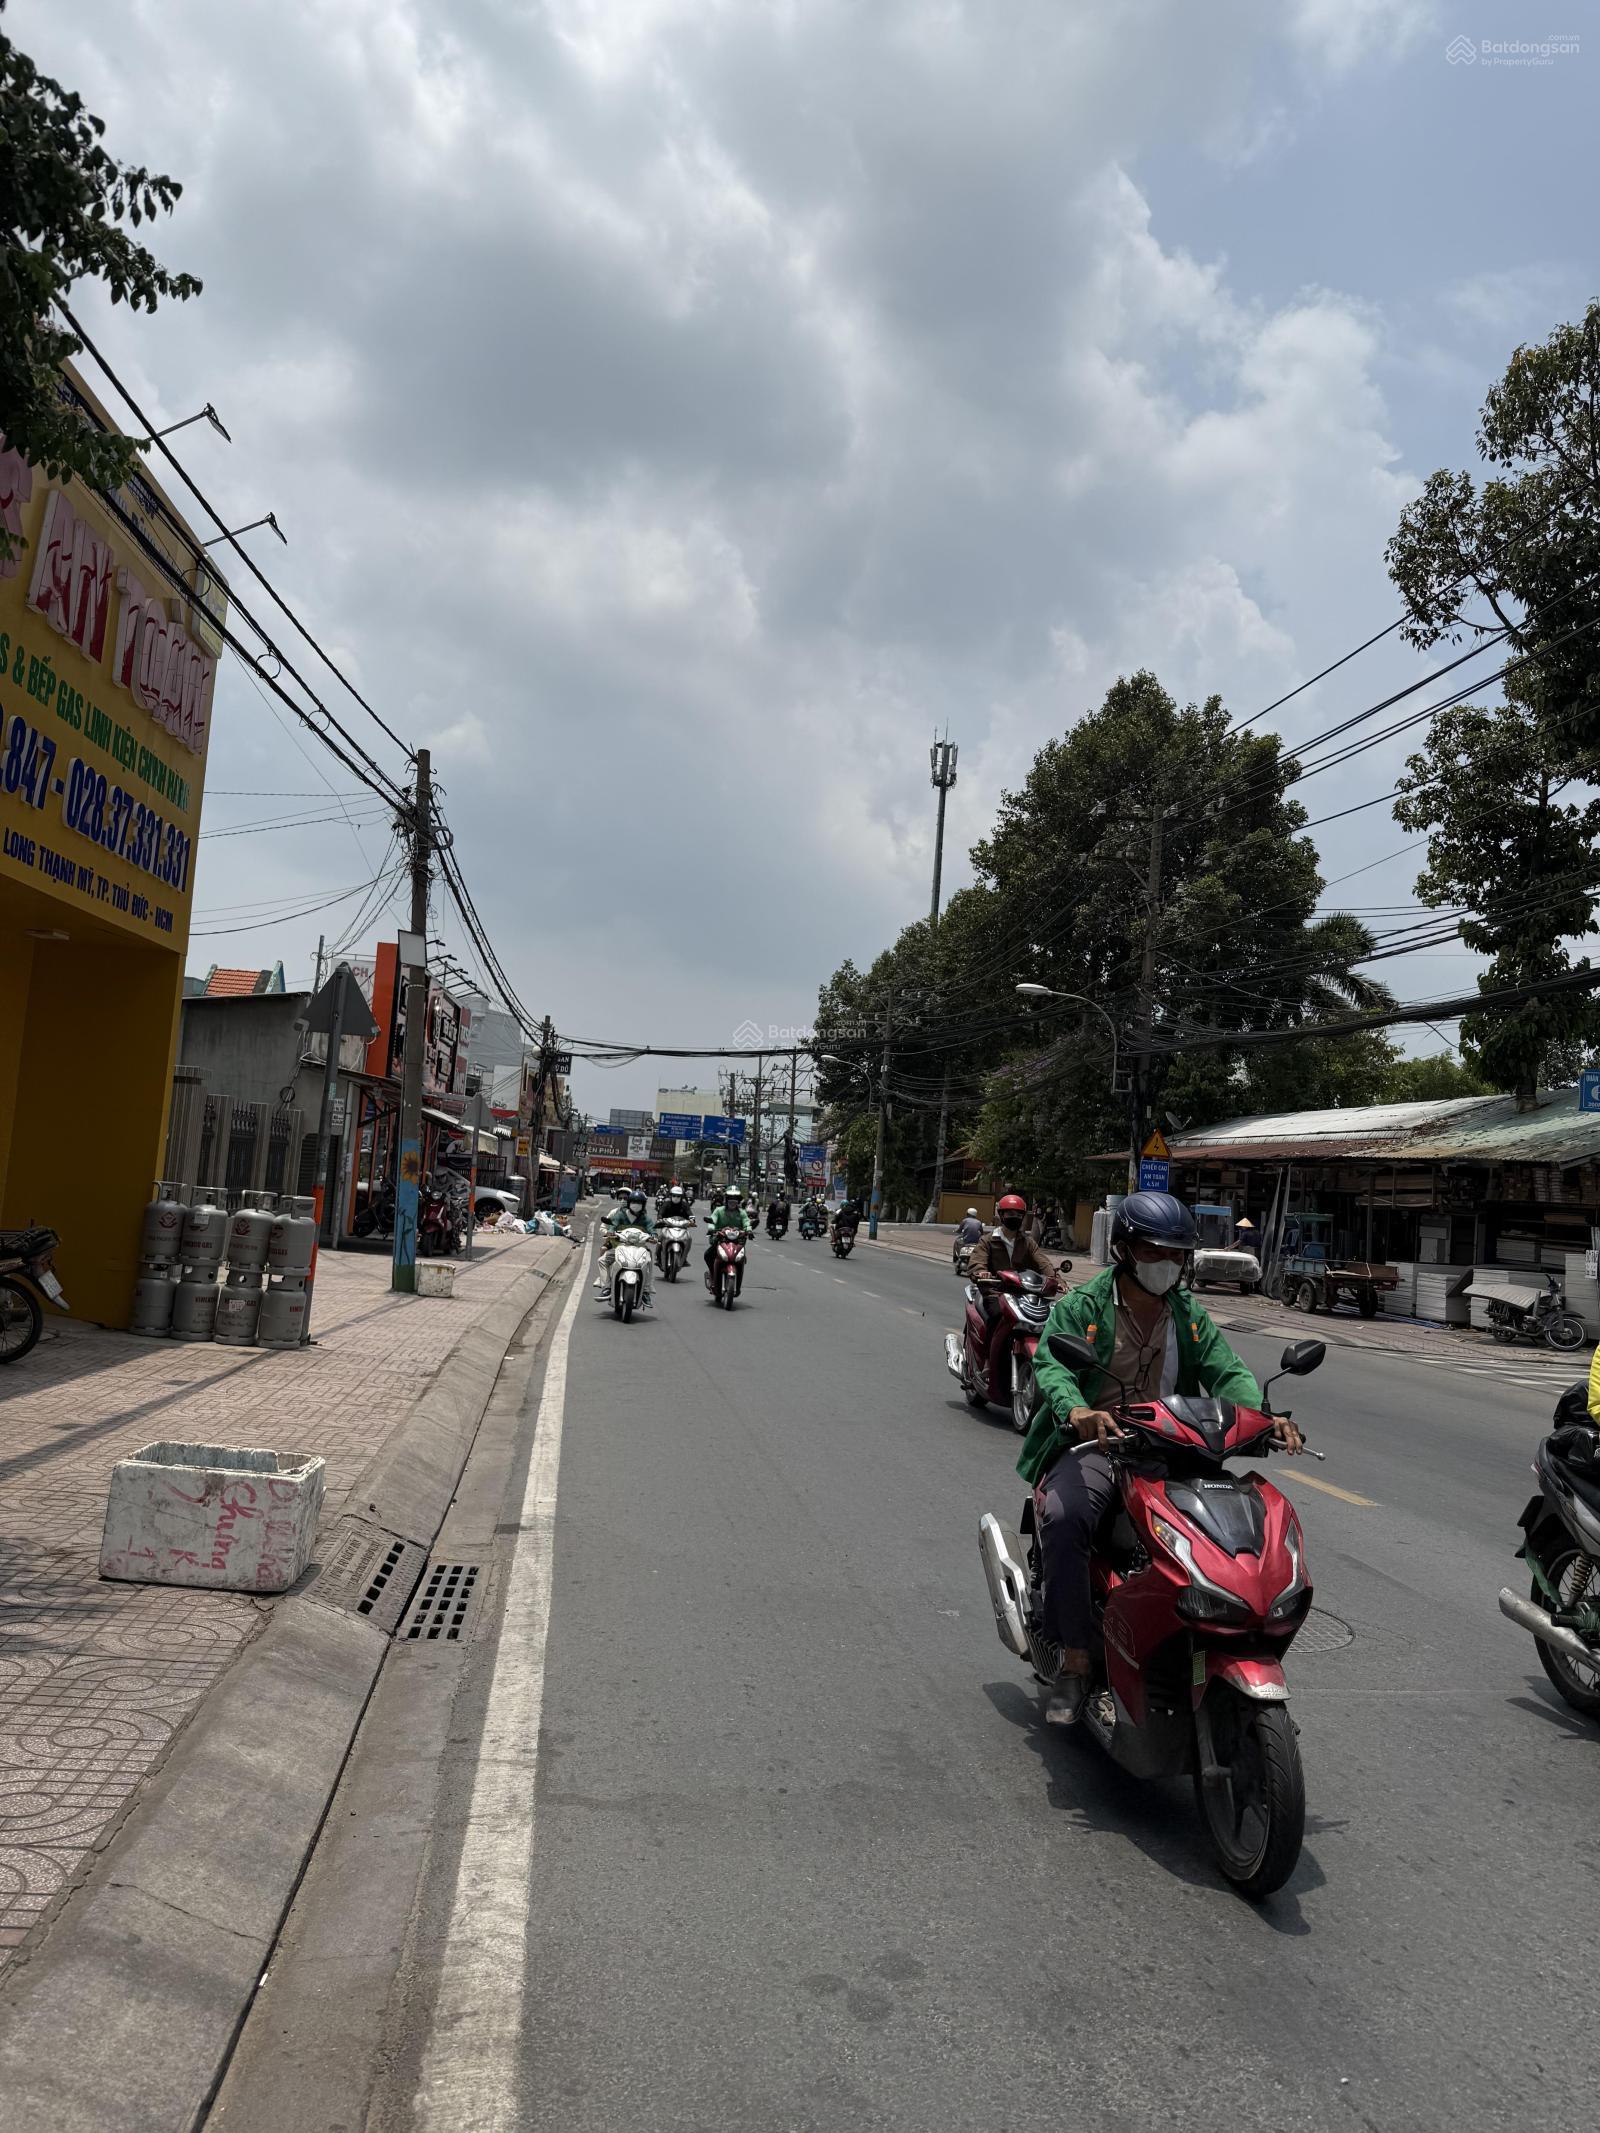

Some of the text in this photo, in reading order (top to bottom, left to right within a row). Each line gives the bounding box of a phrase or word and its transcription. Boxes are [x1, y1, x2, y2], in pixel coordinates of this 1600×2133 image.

[12, 646, 25, 687] &
[27, 655, 56, 706] BẾP
[57, 680, 84, 730] GAS
[84, 702, 113, 752] LINH
[112, 726, 138, 773] KIỆN
[4, 827, 36, 867] LONG
[39, 844, 77, 883] THẠNH
[97, 875, 110, 903] TP.
[112, 882, 130, 912] THỦ
[154, 906, 173, 932] HCM
